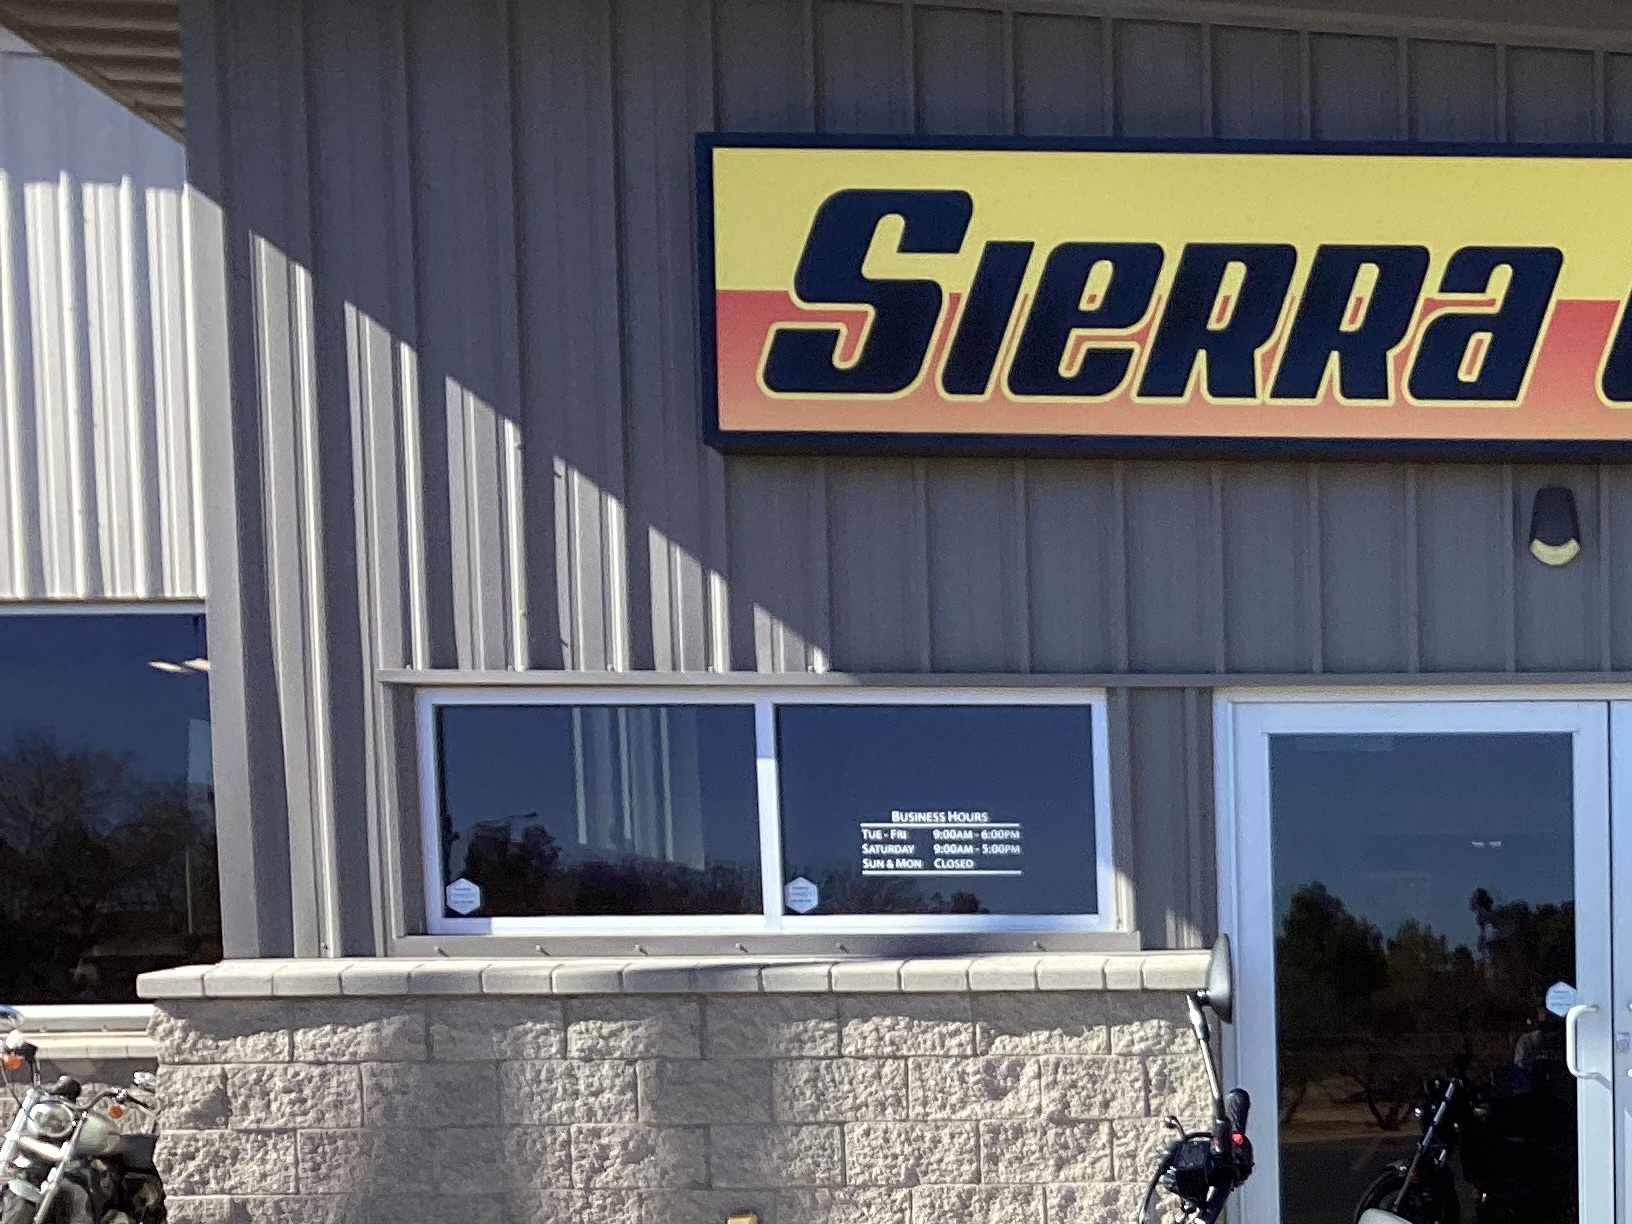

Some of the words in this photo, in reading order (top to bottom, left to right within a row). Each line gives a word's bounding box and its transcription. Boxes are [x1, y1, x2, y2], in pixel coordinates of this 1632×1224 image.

[891, 810, 945, 823] BUSINESS
[947, 810, 988, 823] HOURS
[861, 829, 882, 840] TUE
[890, 829, 907, 840] FRI
[932, 829, 973, 840] 9:00AM
[980, 829, 1020, 840] 6:00PM
[861, 843, 915, 855] SATURDAY
[933, 843, 973, 855] 9:00AM
[981, 843, 1021, 855] 5:00PM
[862, 857, 885, 869] SUN
[886, 858, 895, 869] &
[895, 857, 922, 869] MON
[933, 857, 974, 869] CLOSED
